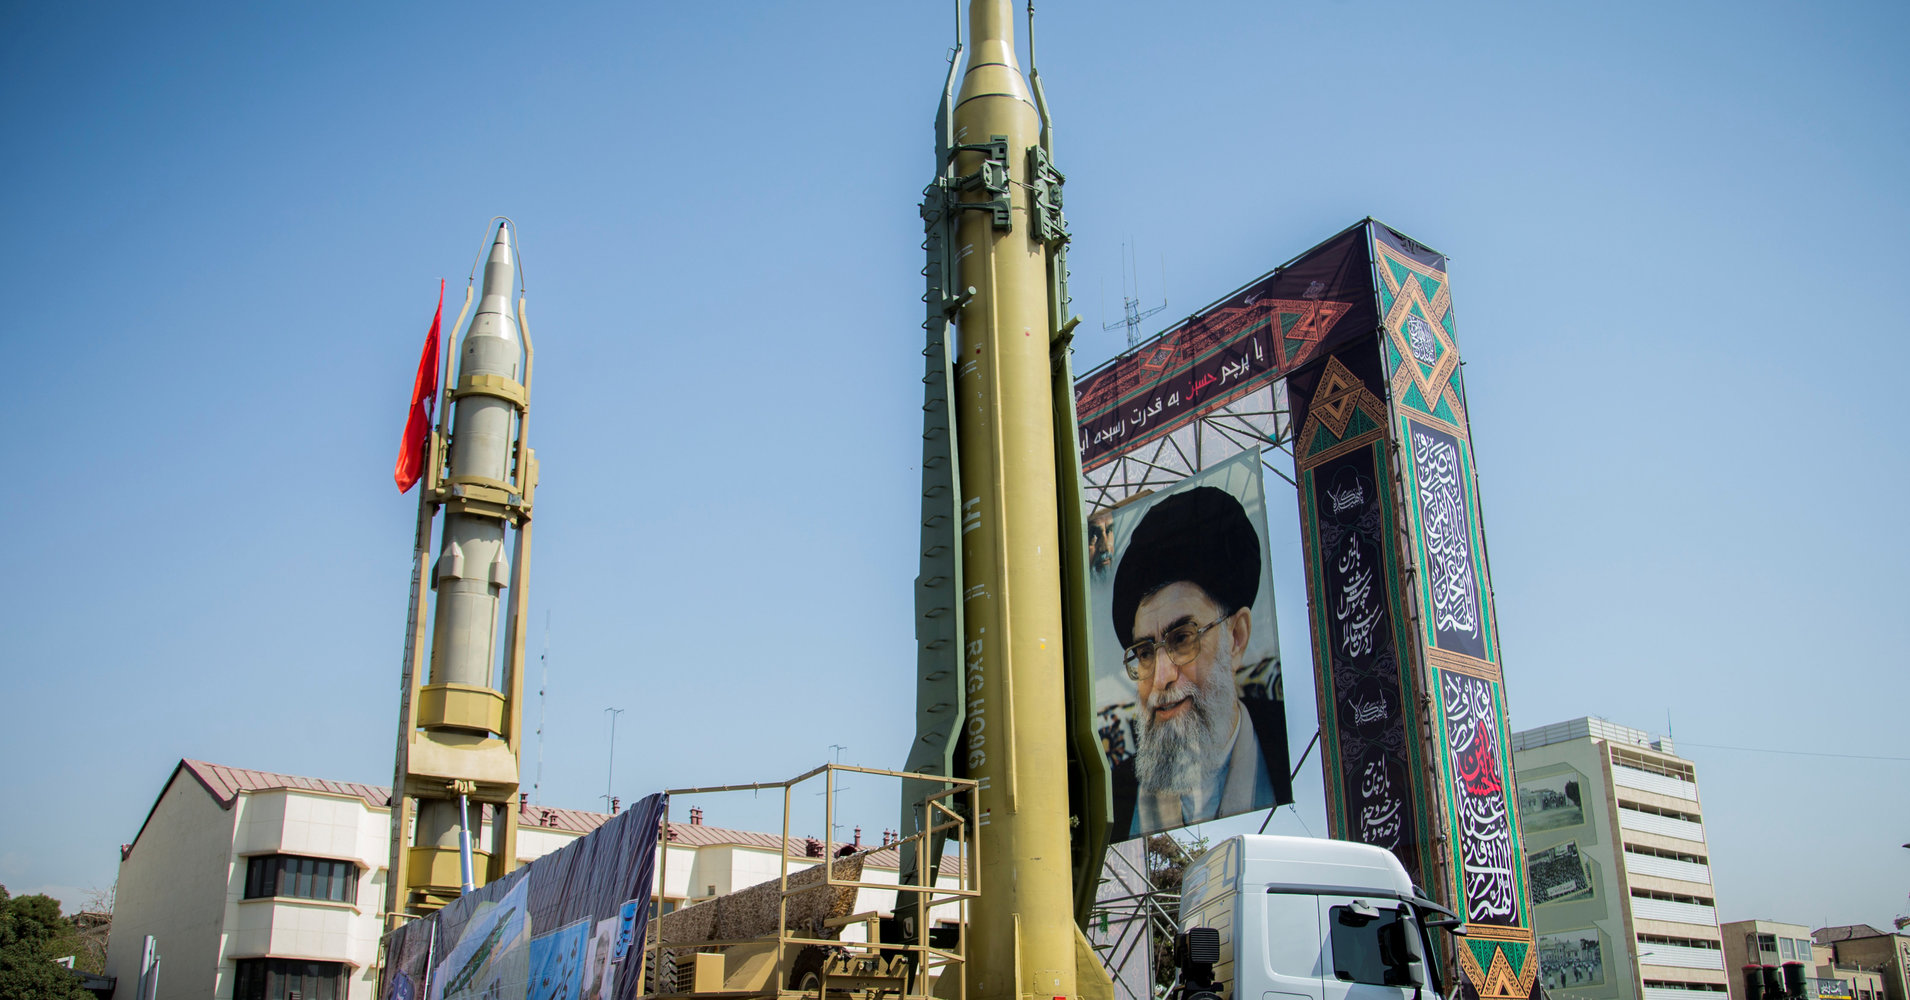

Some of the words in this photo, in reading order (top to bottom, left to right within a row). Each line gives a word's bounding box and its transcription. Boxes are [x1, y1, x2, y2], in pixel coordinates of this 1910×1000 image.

[1253, 337, 1264, 362] با
[1219, 353, 1249, 385] پرچم
[1167, 391, 1179, 406] به
[1185, 373, 1217, 400] حسین
[1130, 397, 1163, 427] قدرت
[1094, 418, 1126, 444] رسیده
